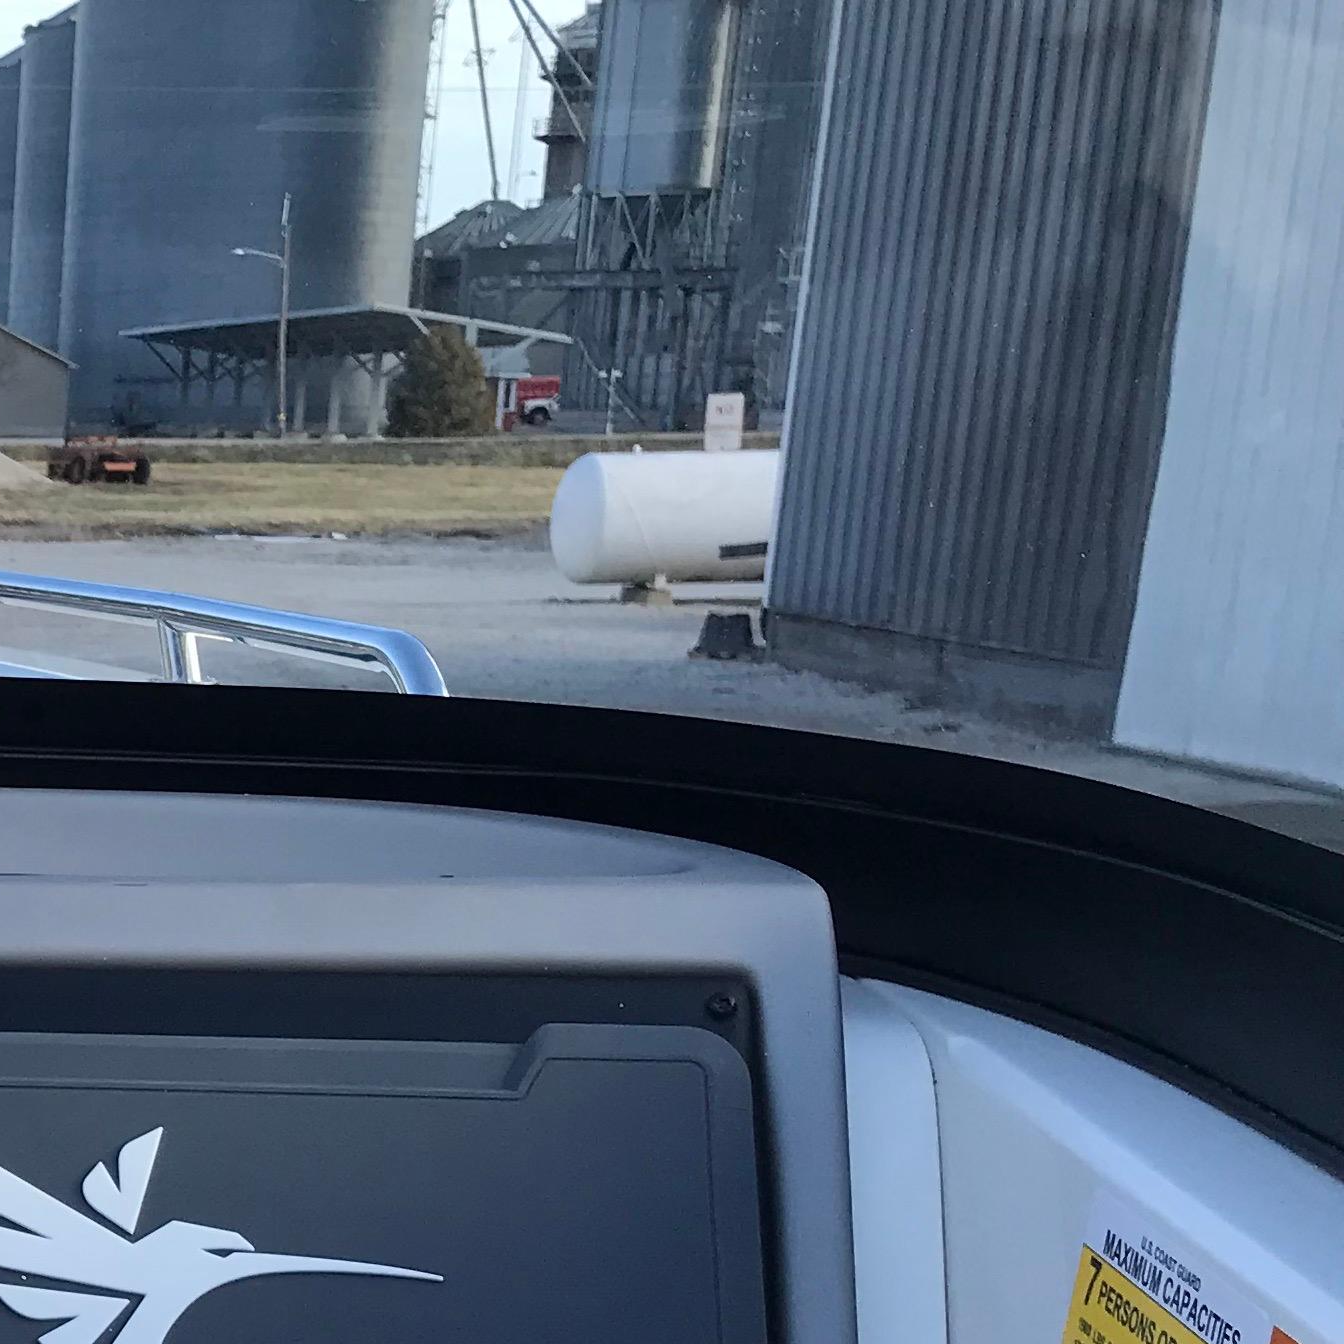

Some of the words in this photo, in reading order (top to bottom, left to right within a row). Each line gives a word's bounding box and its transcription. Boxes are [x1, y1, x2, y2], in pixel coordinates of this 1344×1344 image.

[1084, 1255, 1103, 1306] 7
[1103, 1229, 1163, 1296] MAXIMUM
[1154, 1246, 1177, 1272] COAST
[1177, 1264, 1201, 1292] GUARD
